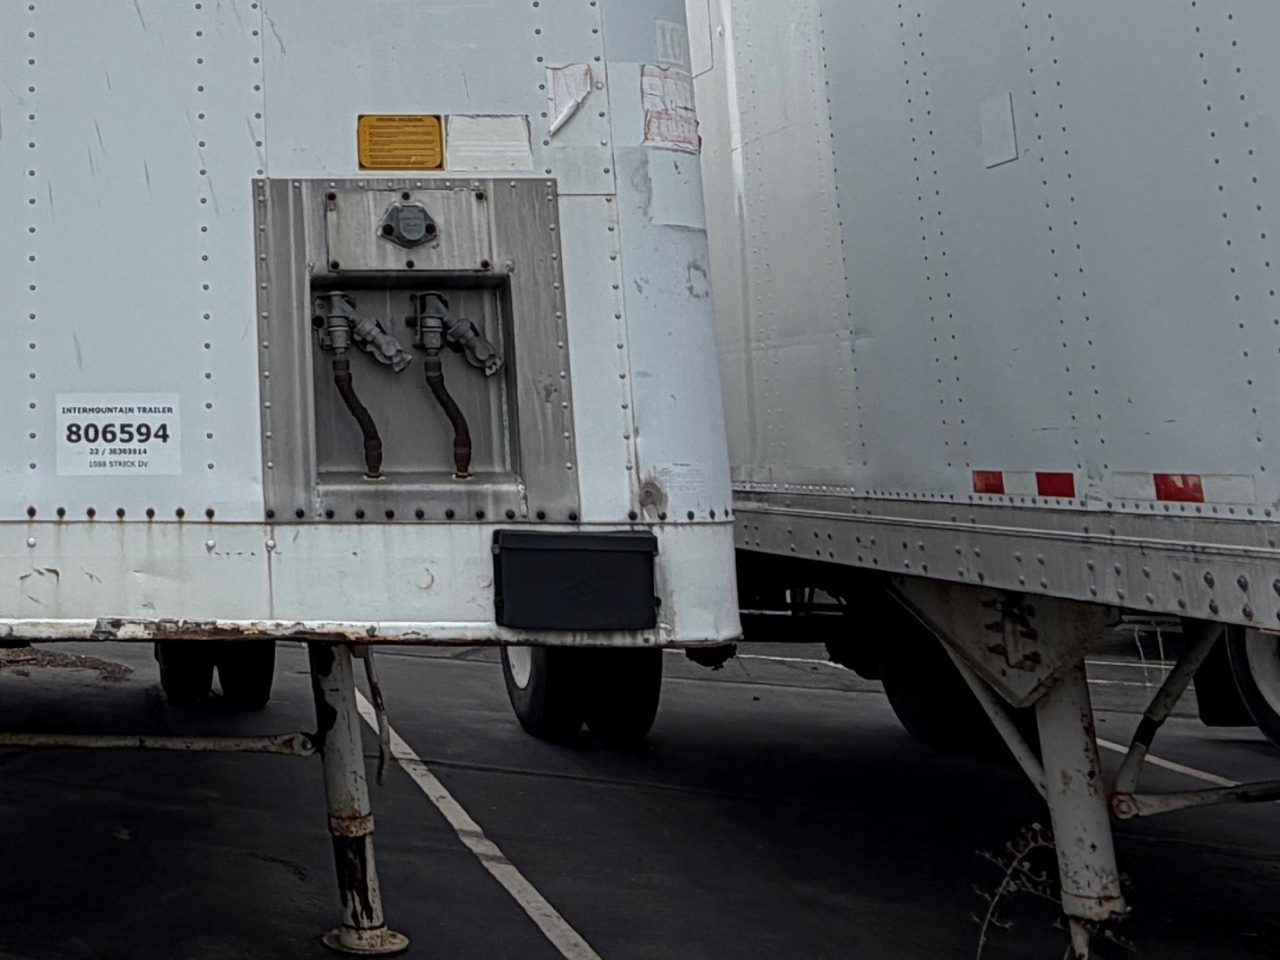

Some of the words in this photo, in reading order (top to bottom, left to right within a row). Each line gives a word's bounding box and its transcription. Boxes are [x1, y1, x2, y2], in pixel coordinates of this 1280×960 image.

[62, 406, 135, 414] INTERMOUNTAIN
[137, 406, 173, 414] TRAILER
[66, 423, 170, 443] 806594
